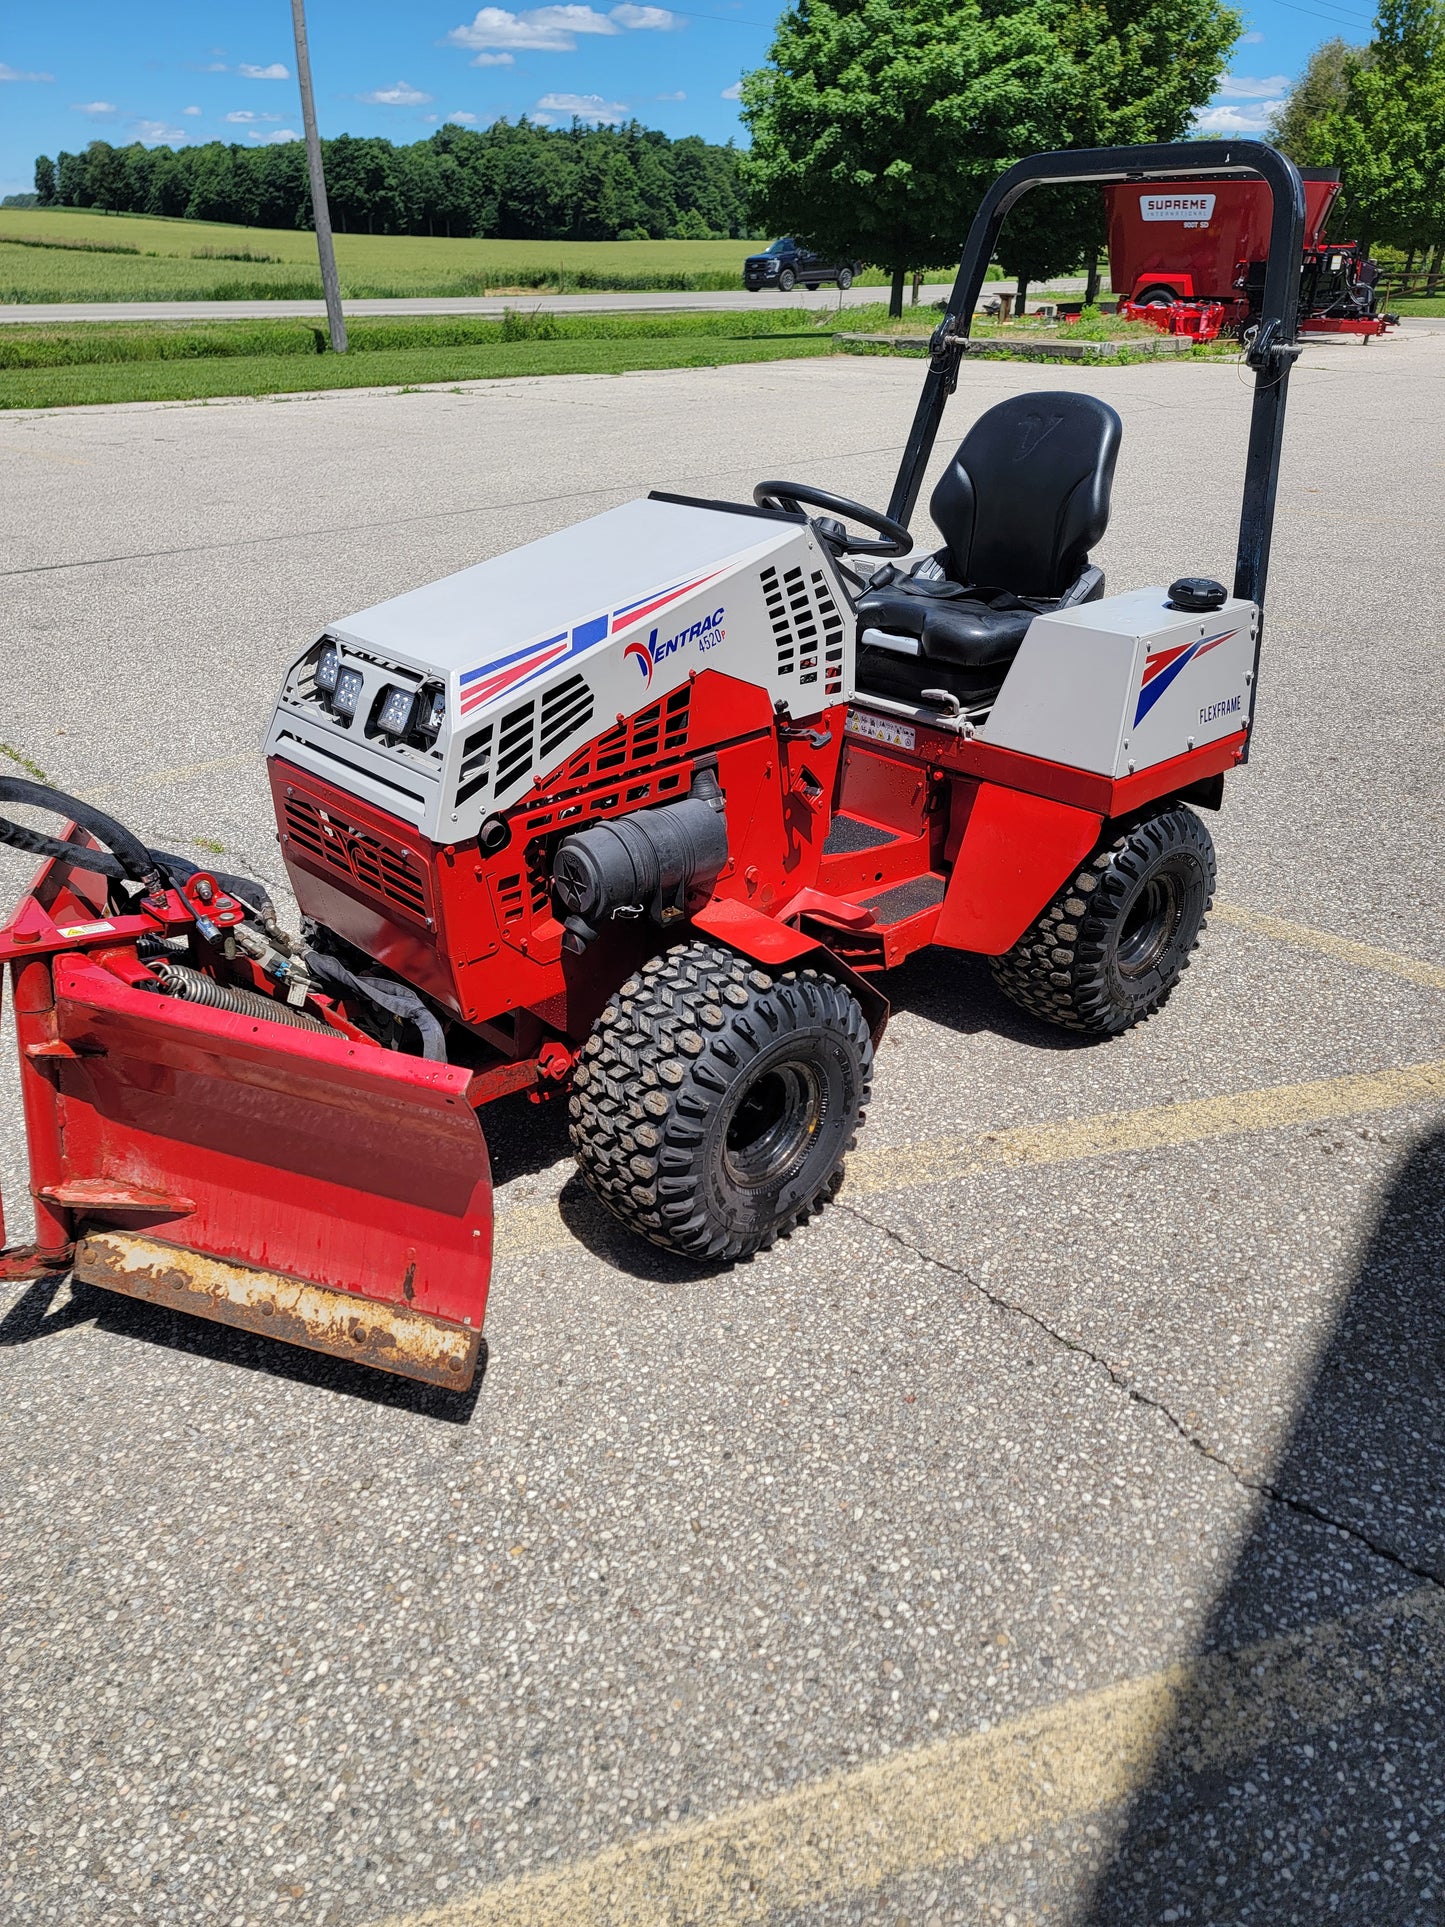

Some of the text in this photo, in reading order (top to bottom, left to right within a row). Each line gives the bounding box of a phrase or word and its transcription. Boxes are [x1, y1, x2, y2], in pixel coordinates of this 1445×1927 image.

[1148, 200, 1207, 210] SUPREME
[624, 607, 725, 684] VENTRAC
[1199, 695, 1241, 725] FLEXFRAME
